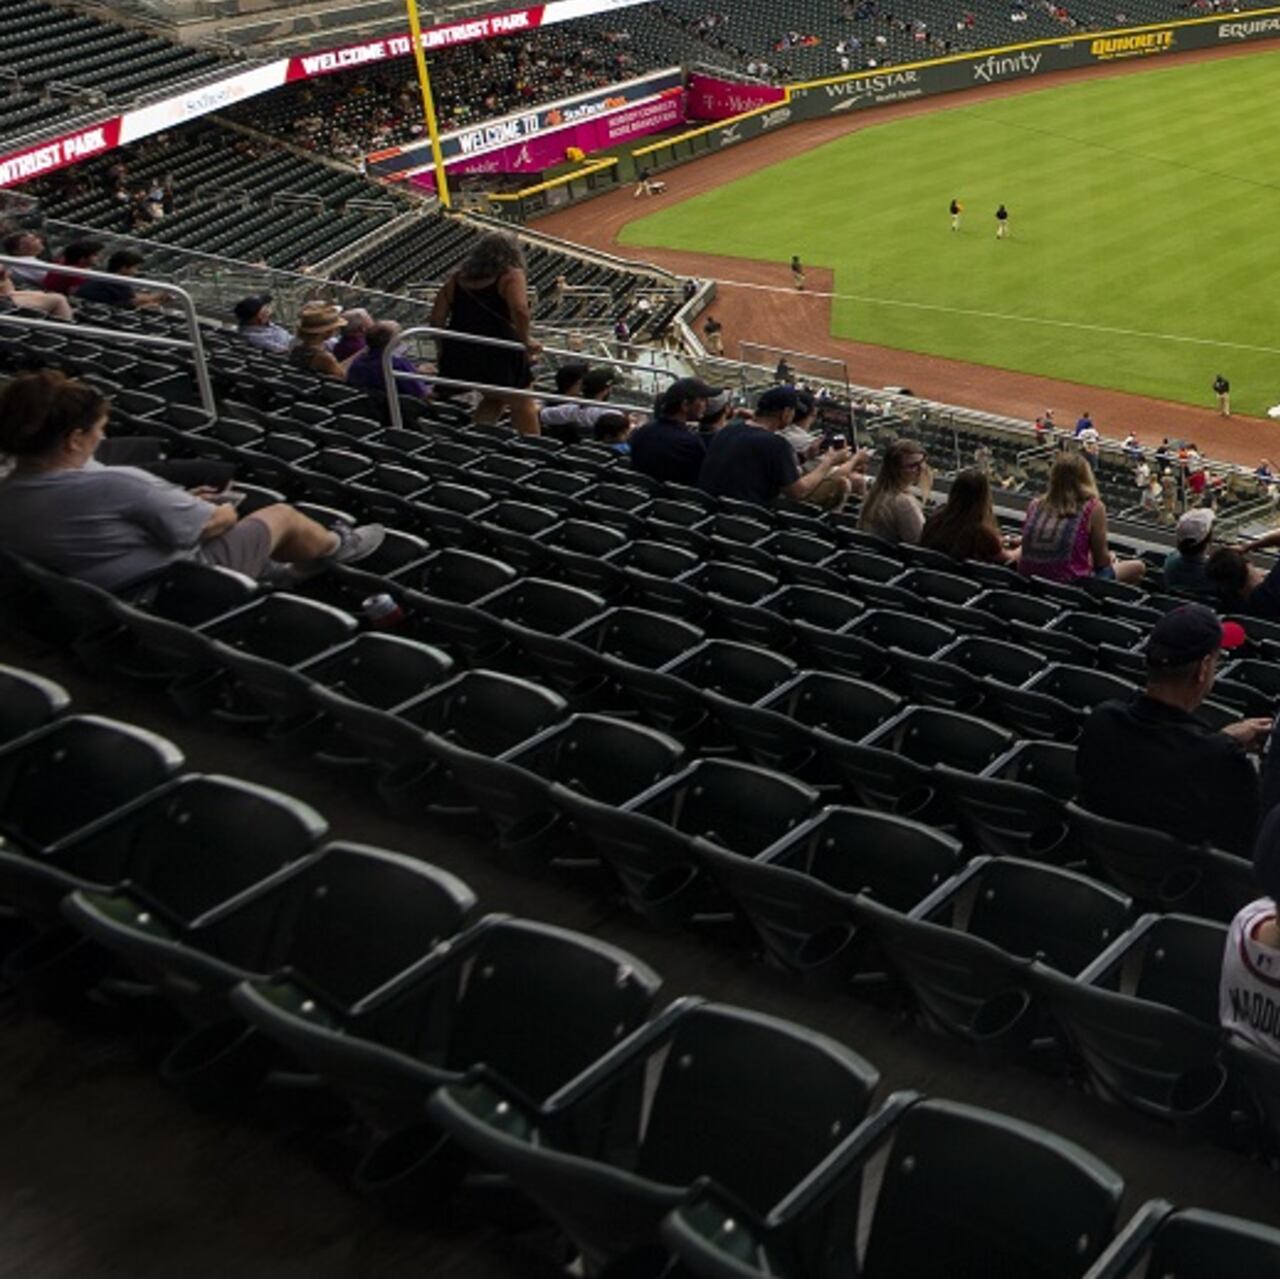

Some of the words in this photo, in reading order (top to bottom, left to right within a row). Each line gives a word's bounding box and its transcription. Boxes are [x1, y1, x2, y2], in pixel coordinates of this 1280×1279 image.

[302, 41, 385, 75] WELCOME
[387, 37, 411, 56] TO
[491, 12, 529, 33] PARK
[973, 51, 1043, 82] xfinity
[825, 71, 918, 97] WELLSTAR
[64, 127, 106, 161] PARK
[458, 122, 522, 154] WELCOME
[523, 114, 540, 133] TO
